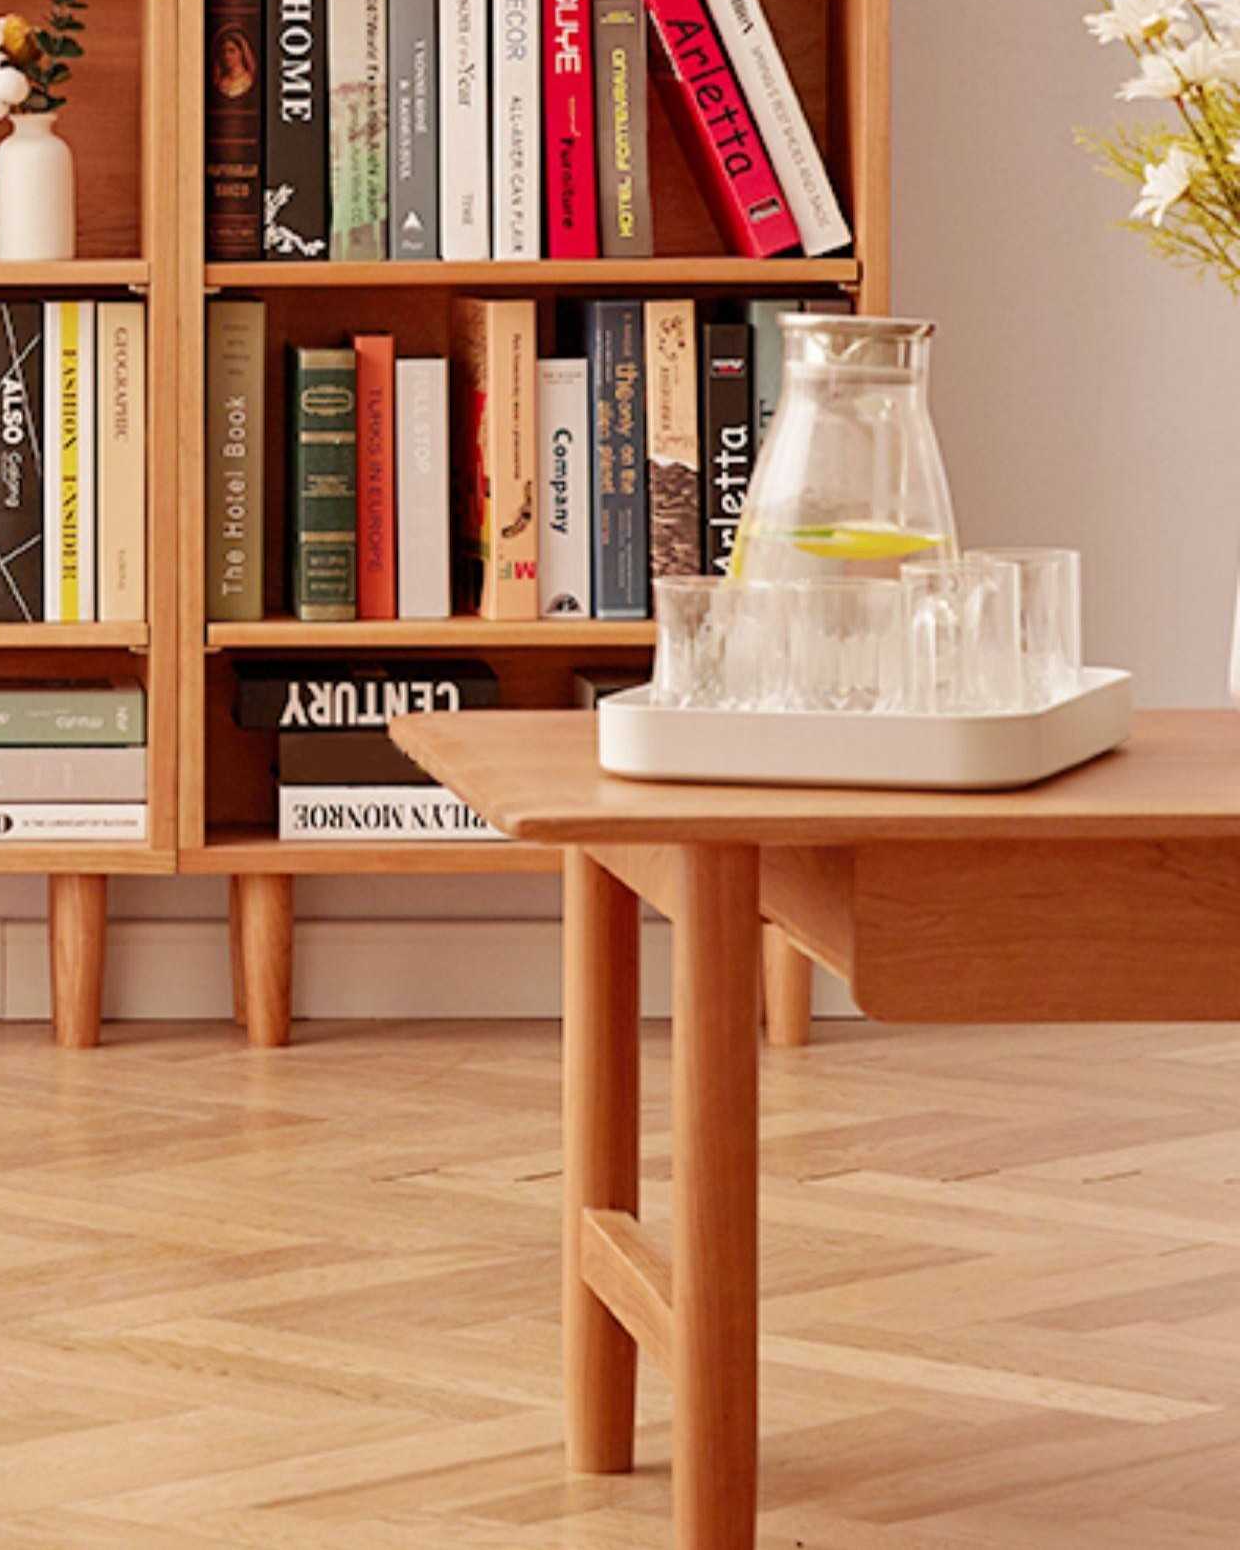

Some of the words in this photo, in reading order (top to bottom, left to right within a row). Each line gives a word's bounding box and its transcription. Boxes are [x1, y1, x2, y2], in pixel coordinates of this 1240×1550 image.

[665, 18, 754, 179] Arletta
[560, 137, 575, 230] Furniture
[617, 176, 634, 238] HOTEL
[2, 378, 23, 445] ALSO
[62, 349, 78, 451] FASHION
[114, 327, 129, 442] GEOGRAPHIC
[222, 395, 246, 458] Book
[222, 470, 245, 538] Hotel
[550, 428, 574, 534] Company
[62, 473, 78, 580] INSIDER
[222, 549, 245, 595] The
[279, 681, 459, 727] CENTURY
[291, 804, 405, 831] MONROE
